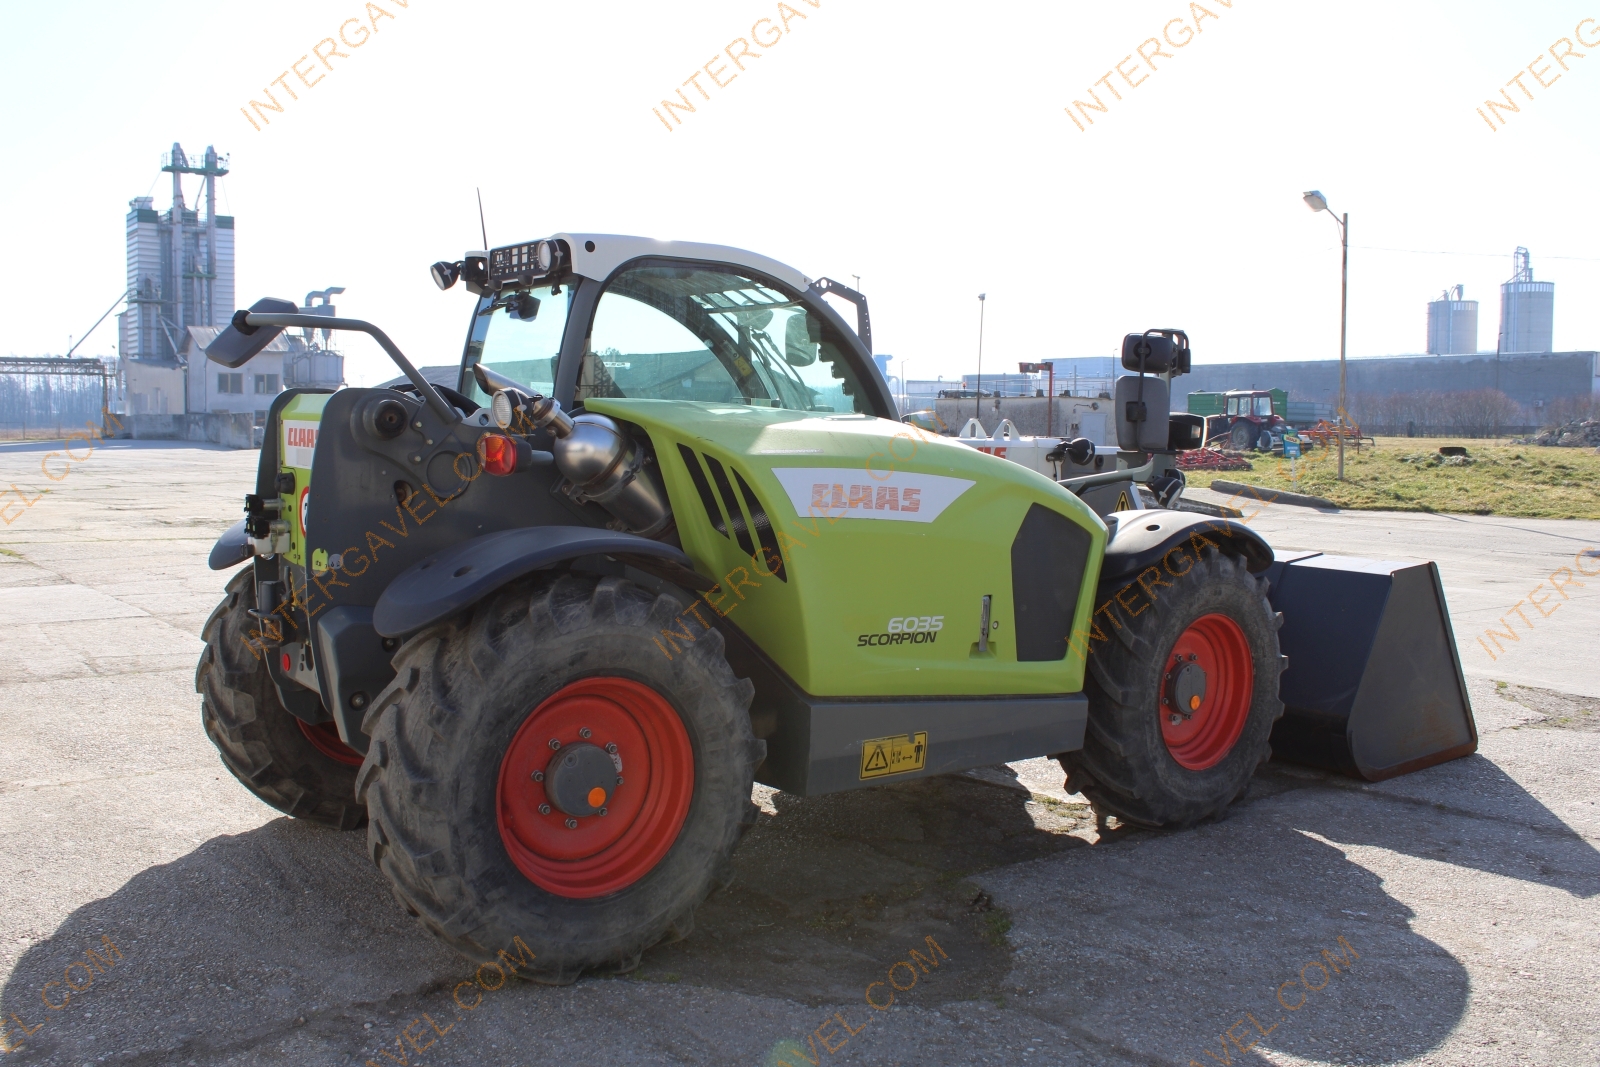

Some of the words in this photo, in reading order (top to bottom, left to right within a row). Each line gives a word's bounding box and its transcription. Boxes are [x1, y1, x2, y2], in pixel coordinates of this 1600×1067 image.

[811, 483, 921, 513] CLAAS
[888, 616, 944, 634] 6035
[857, 631, 938, 647] SCORPION
